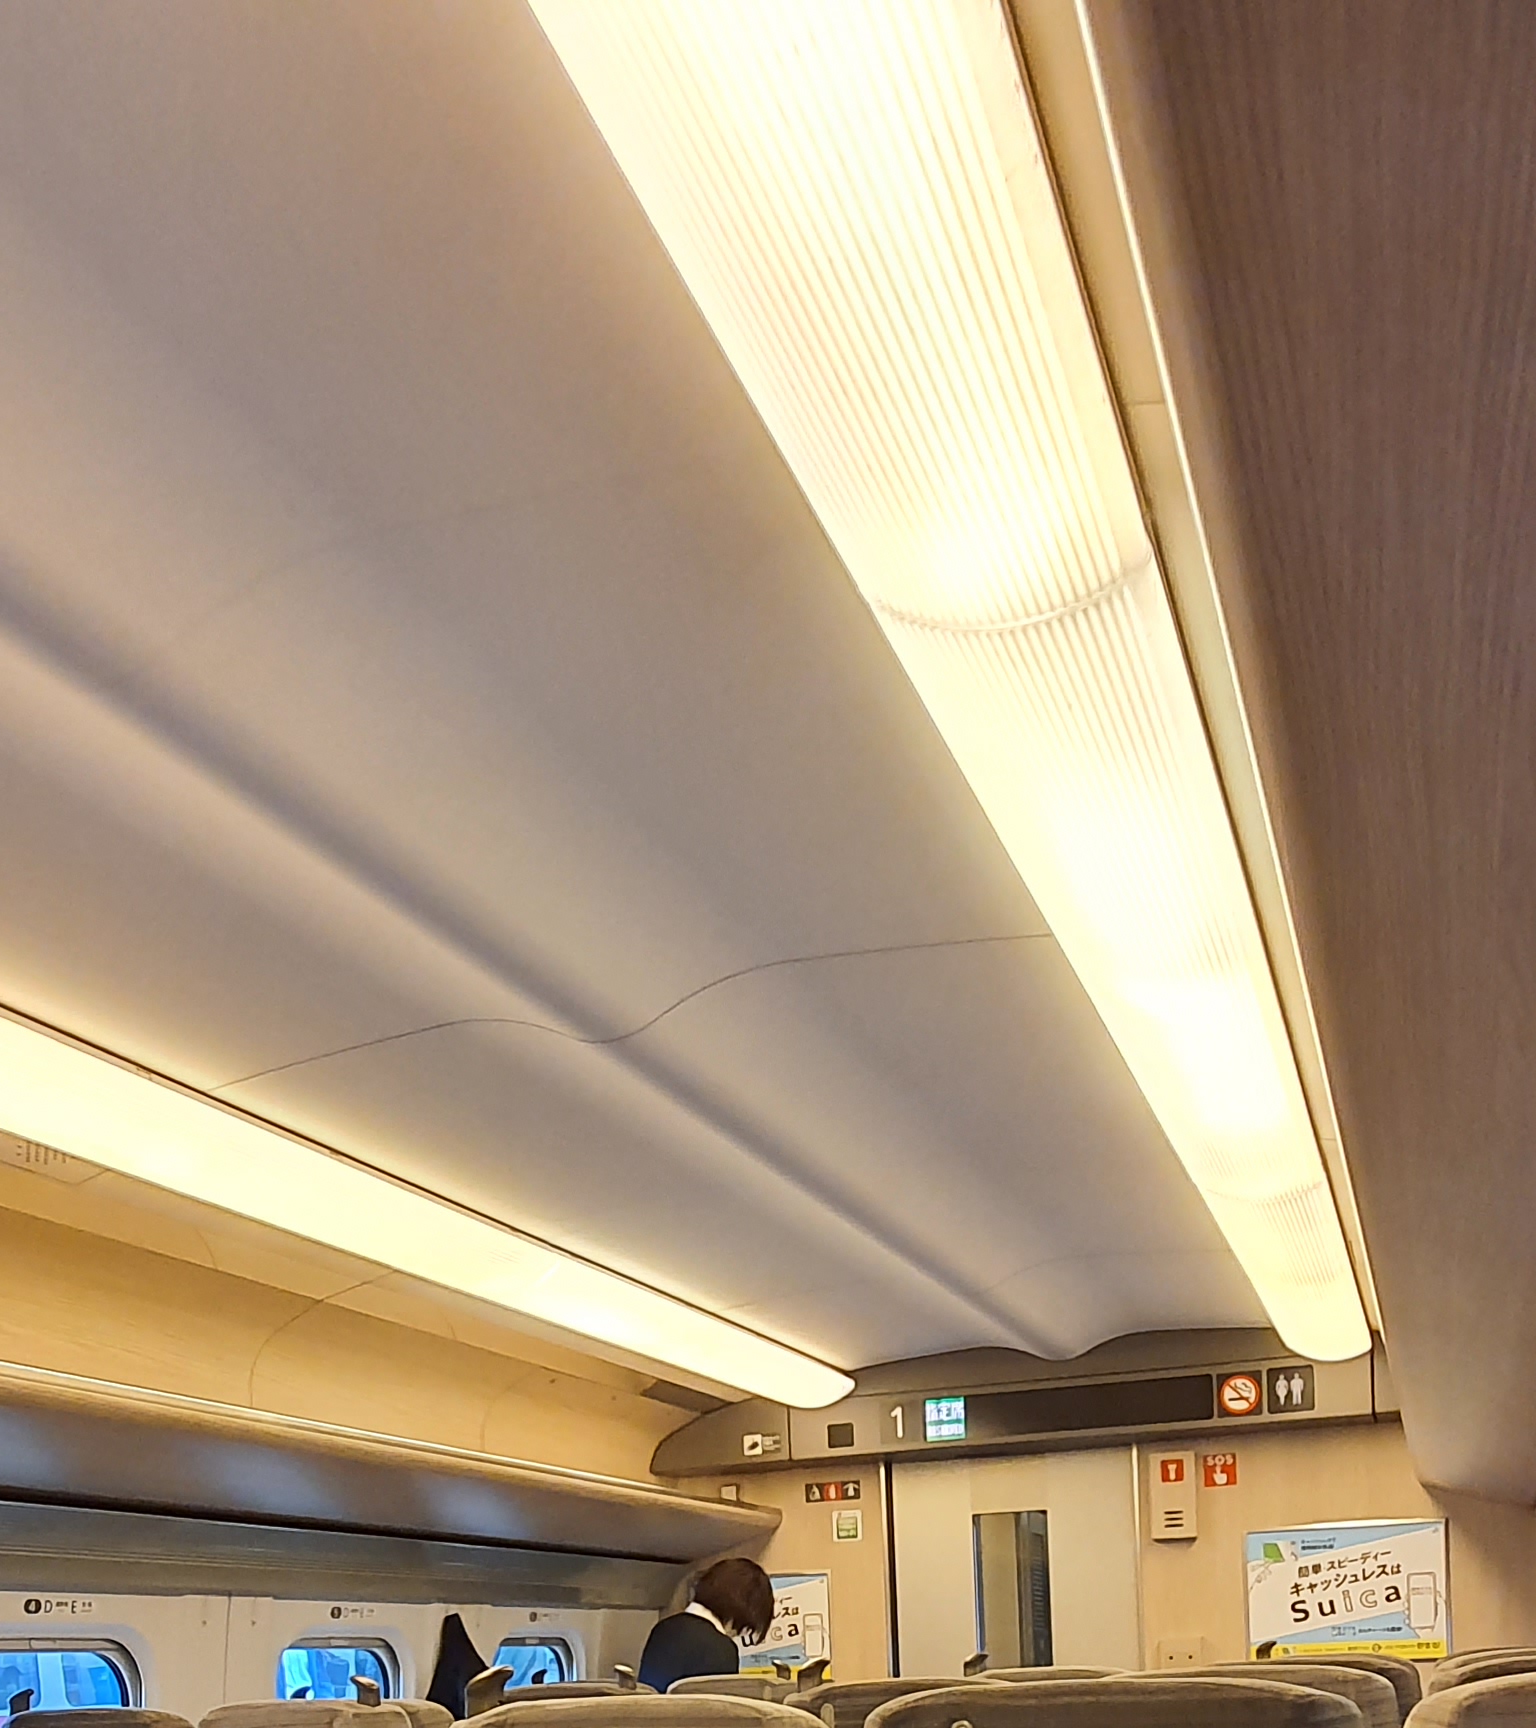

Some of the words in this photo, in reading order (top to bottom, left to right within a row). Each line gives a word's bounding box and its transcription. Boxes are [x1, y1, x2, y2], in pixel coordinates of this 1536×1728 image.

[890, 1405, 904, 1439] 1
[1206, 1454, 1234, 1466] SOS
[1290, 1563, 1402, 1597] キャッシュレスは
[44, 1600, 53, 1613] D
[71, 1600, 77, 1614] E
[1290, 1584, 1402, 1623] Suica
